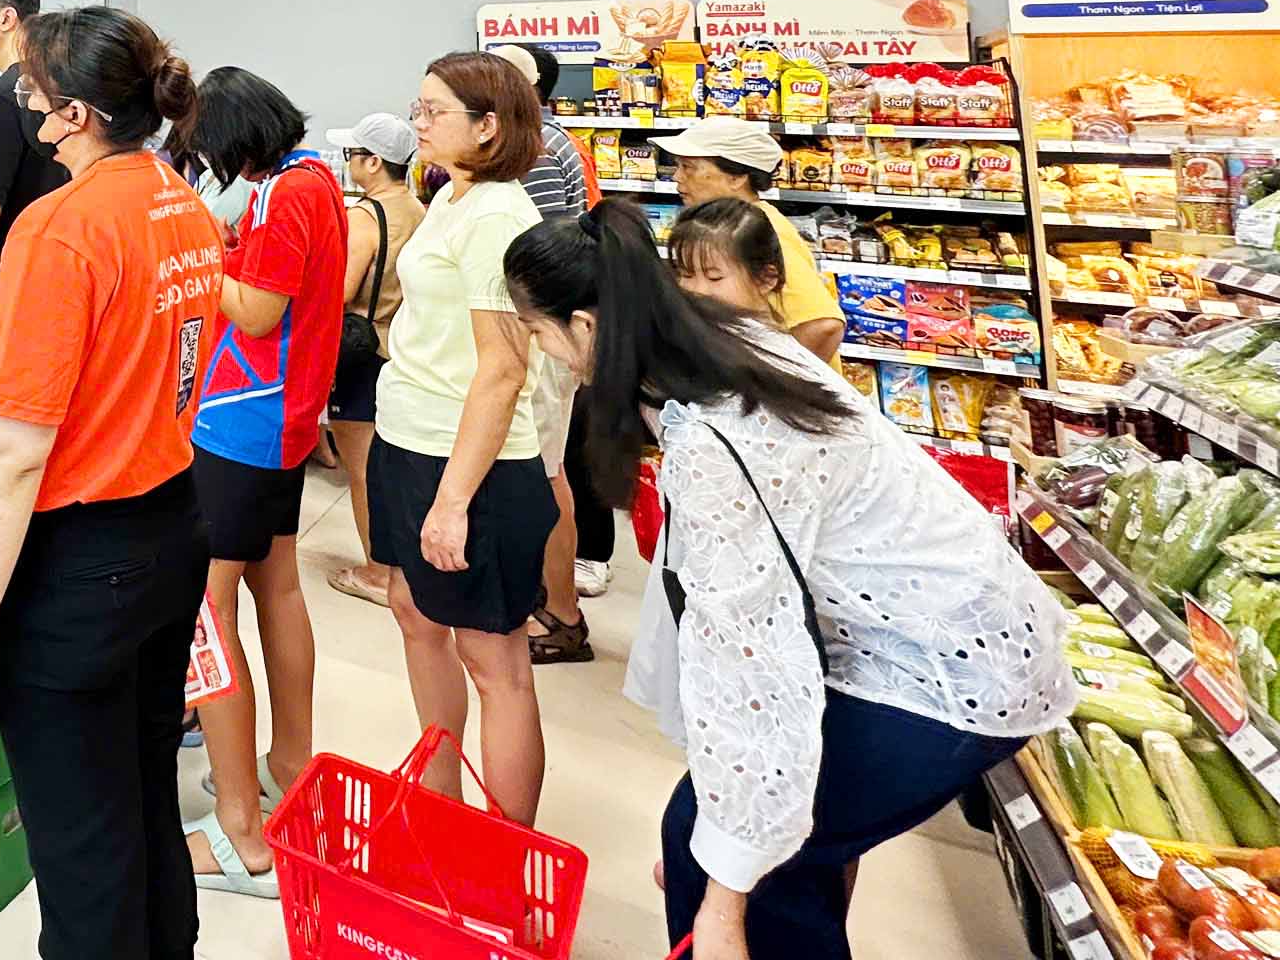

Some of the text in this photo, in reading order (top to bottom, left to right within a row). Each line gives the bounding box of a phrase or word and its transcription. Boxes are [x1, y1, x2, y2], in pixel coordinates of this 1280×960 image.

[705, 1, 766, 12] Yamazaki
[1113, 4, 1145, 16] Ngon
[484, 10, 600, 37] BÁNH MÌ
[706, 17, 800, 37] BÁNH MÌ
[873, 37, 917, 56] TÂY
[883, 96, 913, 109] Staff
[920, 96, 950, 108] Staff
[960, 96, 993, 110] Staff
